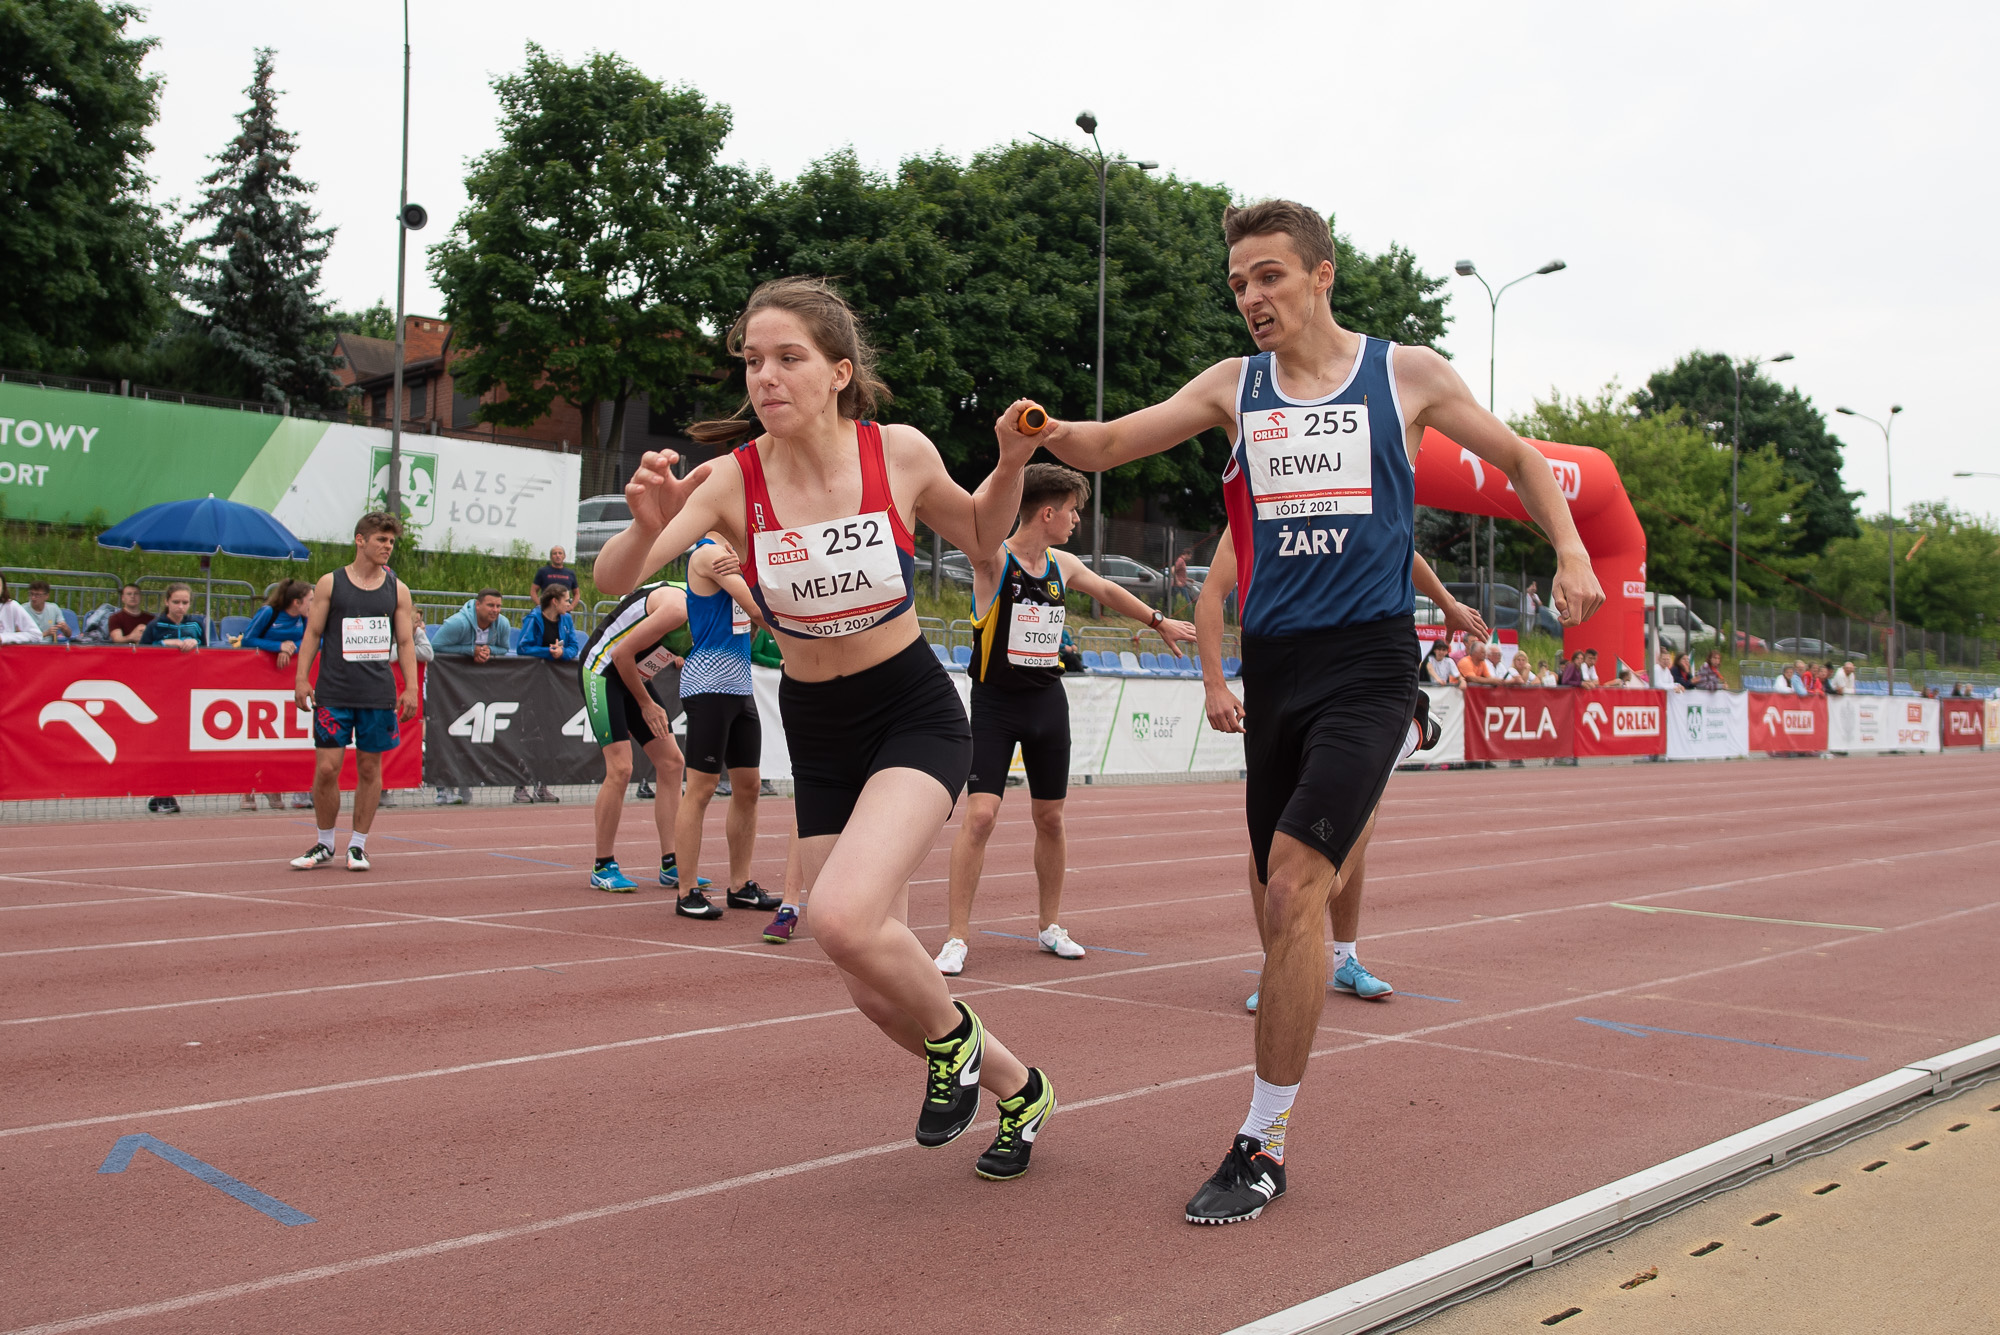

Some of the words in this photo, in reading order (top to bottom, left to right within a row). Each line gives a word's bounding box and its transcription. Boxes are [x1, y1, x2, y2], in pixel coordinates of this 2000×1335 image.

[1254, 429, 1286, 441] ORLEN
[1304, 410, 1358, 437] 255
[1269, 452, 1342, 477] REWAJ
[449, 496, 518, 528] ŁÓDŹ
[1275, 500, 1307, 516] ŁÓDŹ
[1310, 500, 1339, 513] 2021
[822, 520, 884, 556] 252
[1278, 525, 1349, 557] ŻARY
[769, 551, 807, 564] ORLEN
[791, 569, 873, 601] MEJZA
[369, 619, 388, 629] 314
[806, 620, 841, 636] ŁÓDŹ
[844, 616, 876, 632] 2021
[345, 635, 389, 645] ANDRZEJAK
[1024, 631, 1058, 644] STOSIK
[590, 681, 599, 714] CZAPLA
[202, 698, 322, 741] ORL
[448, 701, 520, 743] 4F
[1484, 706, 1558, 740] PZLA
[1616, 710, 1656, 731] ORLEN
[1785, 714, 1812, 729] ORLEN
[1950, 711, 1983, 735] PZLA
